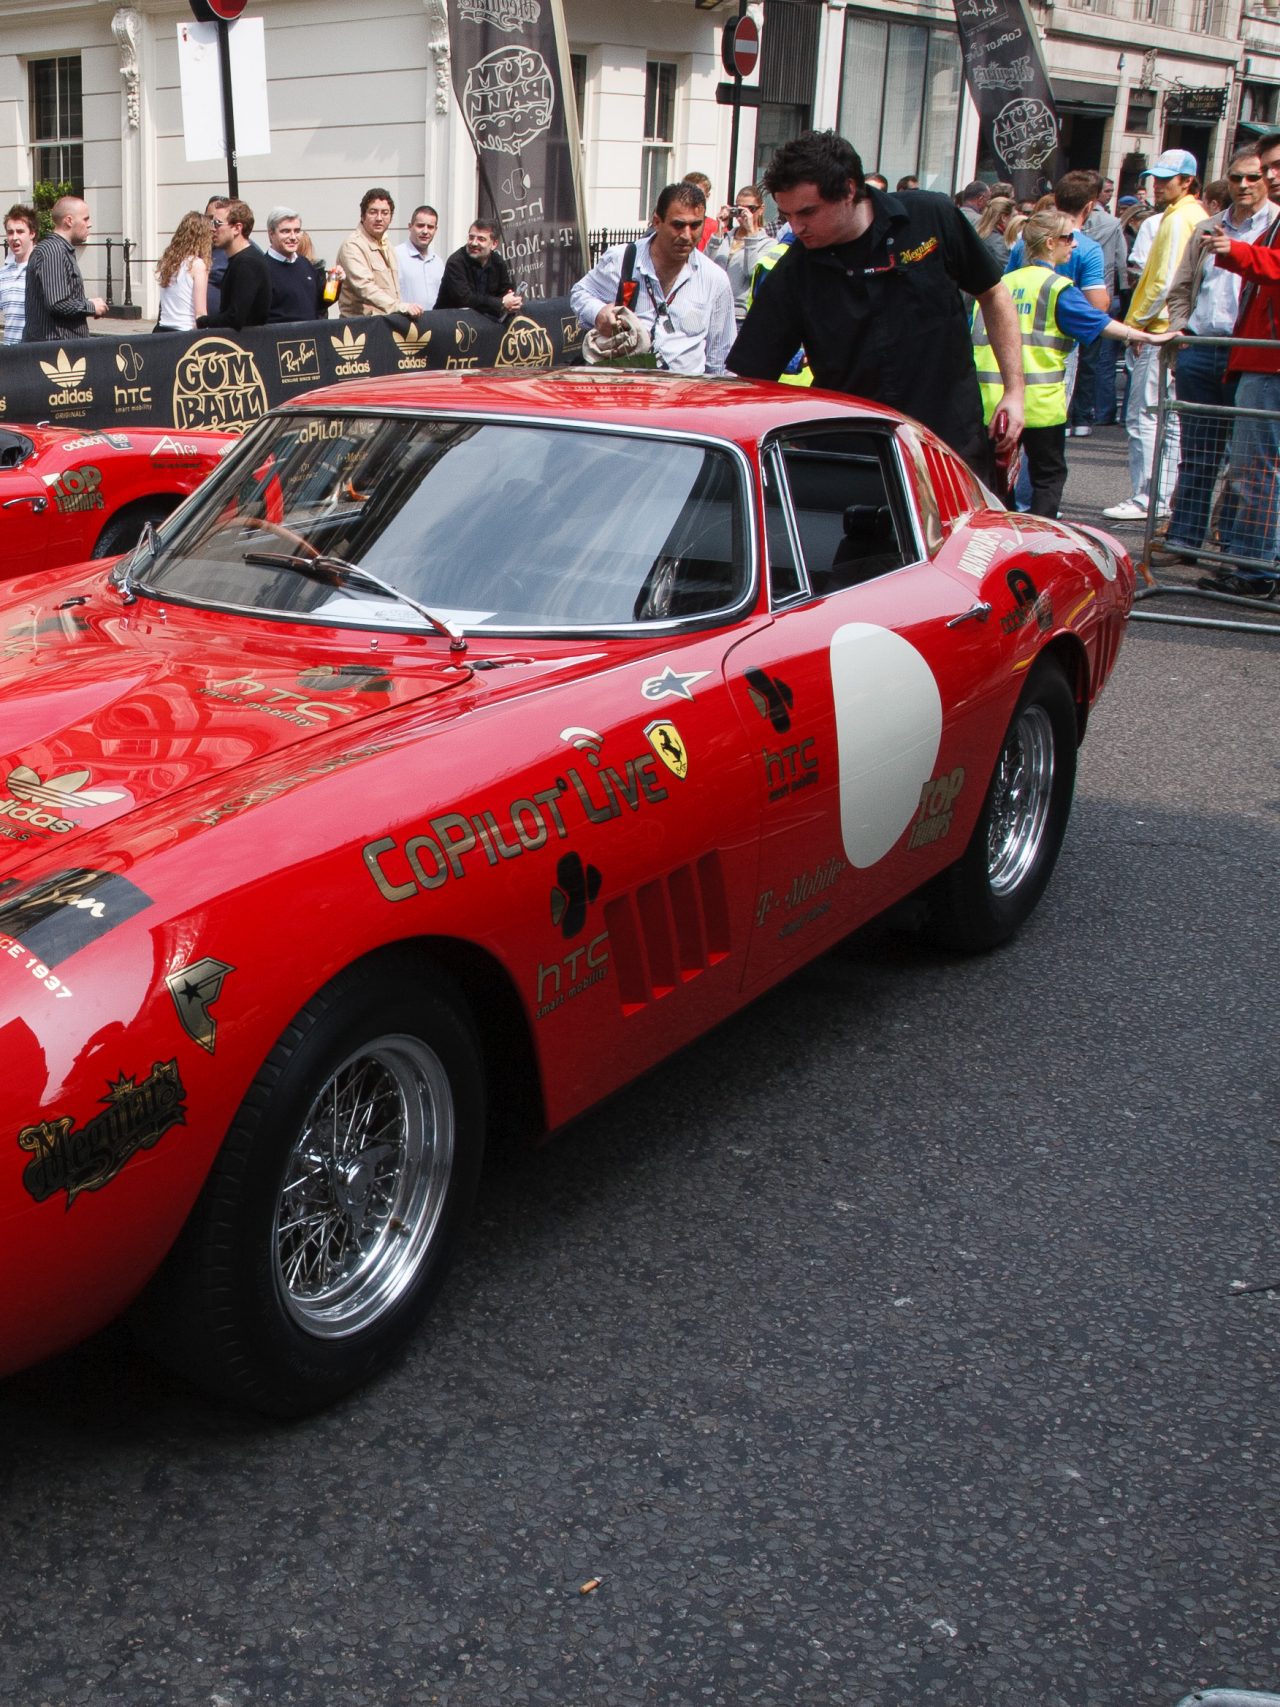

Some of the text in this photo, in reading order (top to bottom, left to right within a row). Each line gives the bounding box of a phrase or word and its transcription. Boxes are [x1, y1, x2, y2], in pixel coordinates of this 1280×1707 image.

[176, 351, 260, 394] GUM
[335, 361, 370, 376] adidas
[398, 356, 427, 370] adidas
[49, 387, 93, 406] adidas
[177, 385, 264, 430] BALL
[55, 410, 86, 419] ORIGINALS
[41, 465, 103, 498] TOP
[53, 491, 105, 514] TRUMPS
[197, 686, 316, 728] smart mobility
[25, 958, 73, 999] 1937
